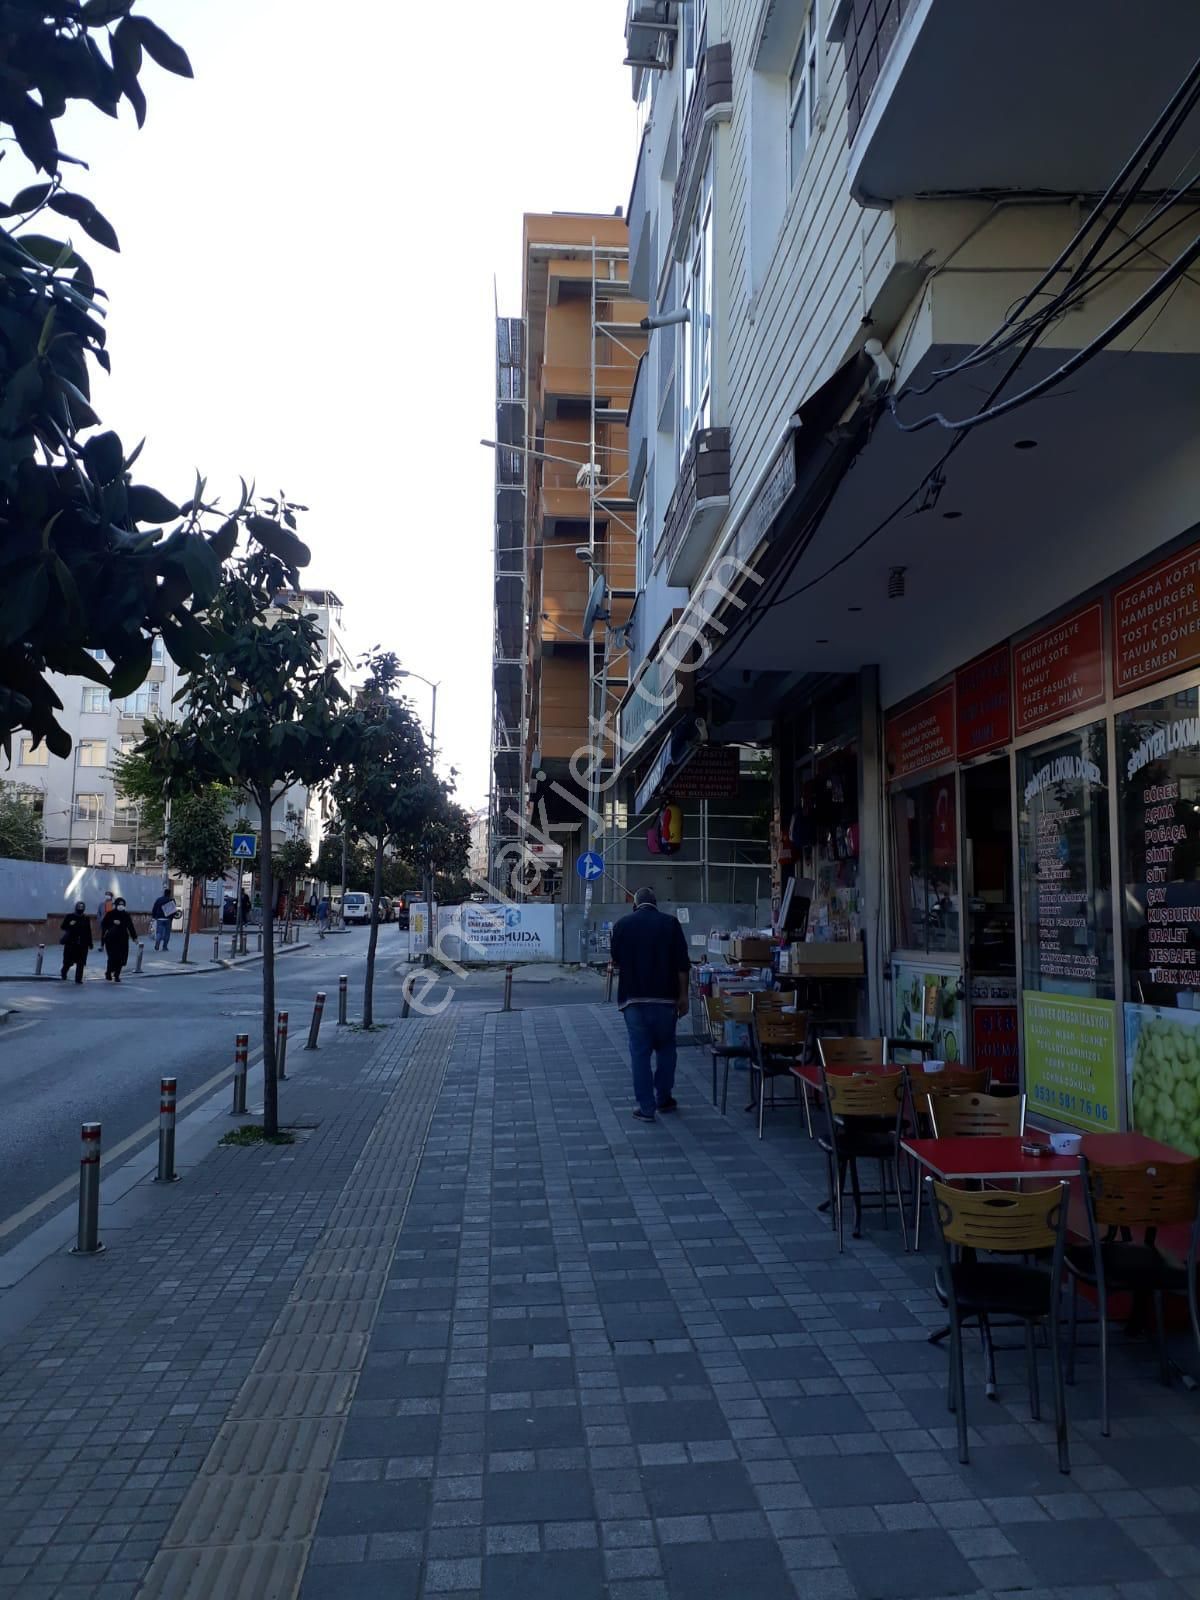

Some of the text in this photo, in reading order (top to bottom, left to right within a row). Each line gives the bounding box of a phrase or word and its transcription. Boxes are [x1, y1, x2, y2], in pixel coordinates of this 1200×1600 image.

[1120, 579, 1163, 612] IZGARA
[1120, 583, 1195, 628] HAMBURGER
[1121, 599, 1200, 645] TOST ÇEŞİTLE
[1021, 623, 1080, 662] KURU FASULYE
[1122, 639, 1158, 663] TAVUK
[1022, 656, 1047, 676] TAVUK
[1122, 648, 1178, 682] MELEMEN
[1022, 670, 1050, 690] NOHUT
[1023, 672, 1078, 706] TAZE FASULYE
[1023, 702, 1049, 721] ÇORBA
[1058, 687, 1083, 706] PİLAV
[1051, 755, 1075, 784] LOKMA
[1075, 755, 1102, 784] DÖNER
[1143, 782, 1179, 804] BÖREK
[1144, 803, 1175, 825] AÇMA
[1144, 824, 1188, 844] POĞAÇA
[1145, 844, 1175, 864] SİMİT
[1146, 866, 1168, 884] SÜT
[1146, 887, 1167, 906] ÇAY
[1149, 948, 1197, 965] NESCAFE
[1149, 966, 1178, 985] TÜRK
[1080, 1097, 1092, 1116] 76
[1095, 1103, 1108, 1121] 06
